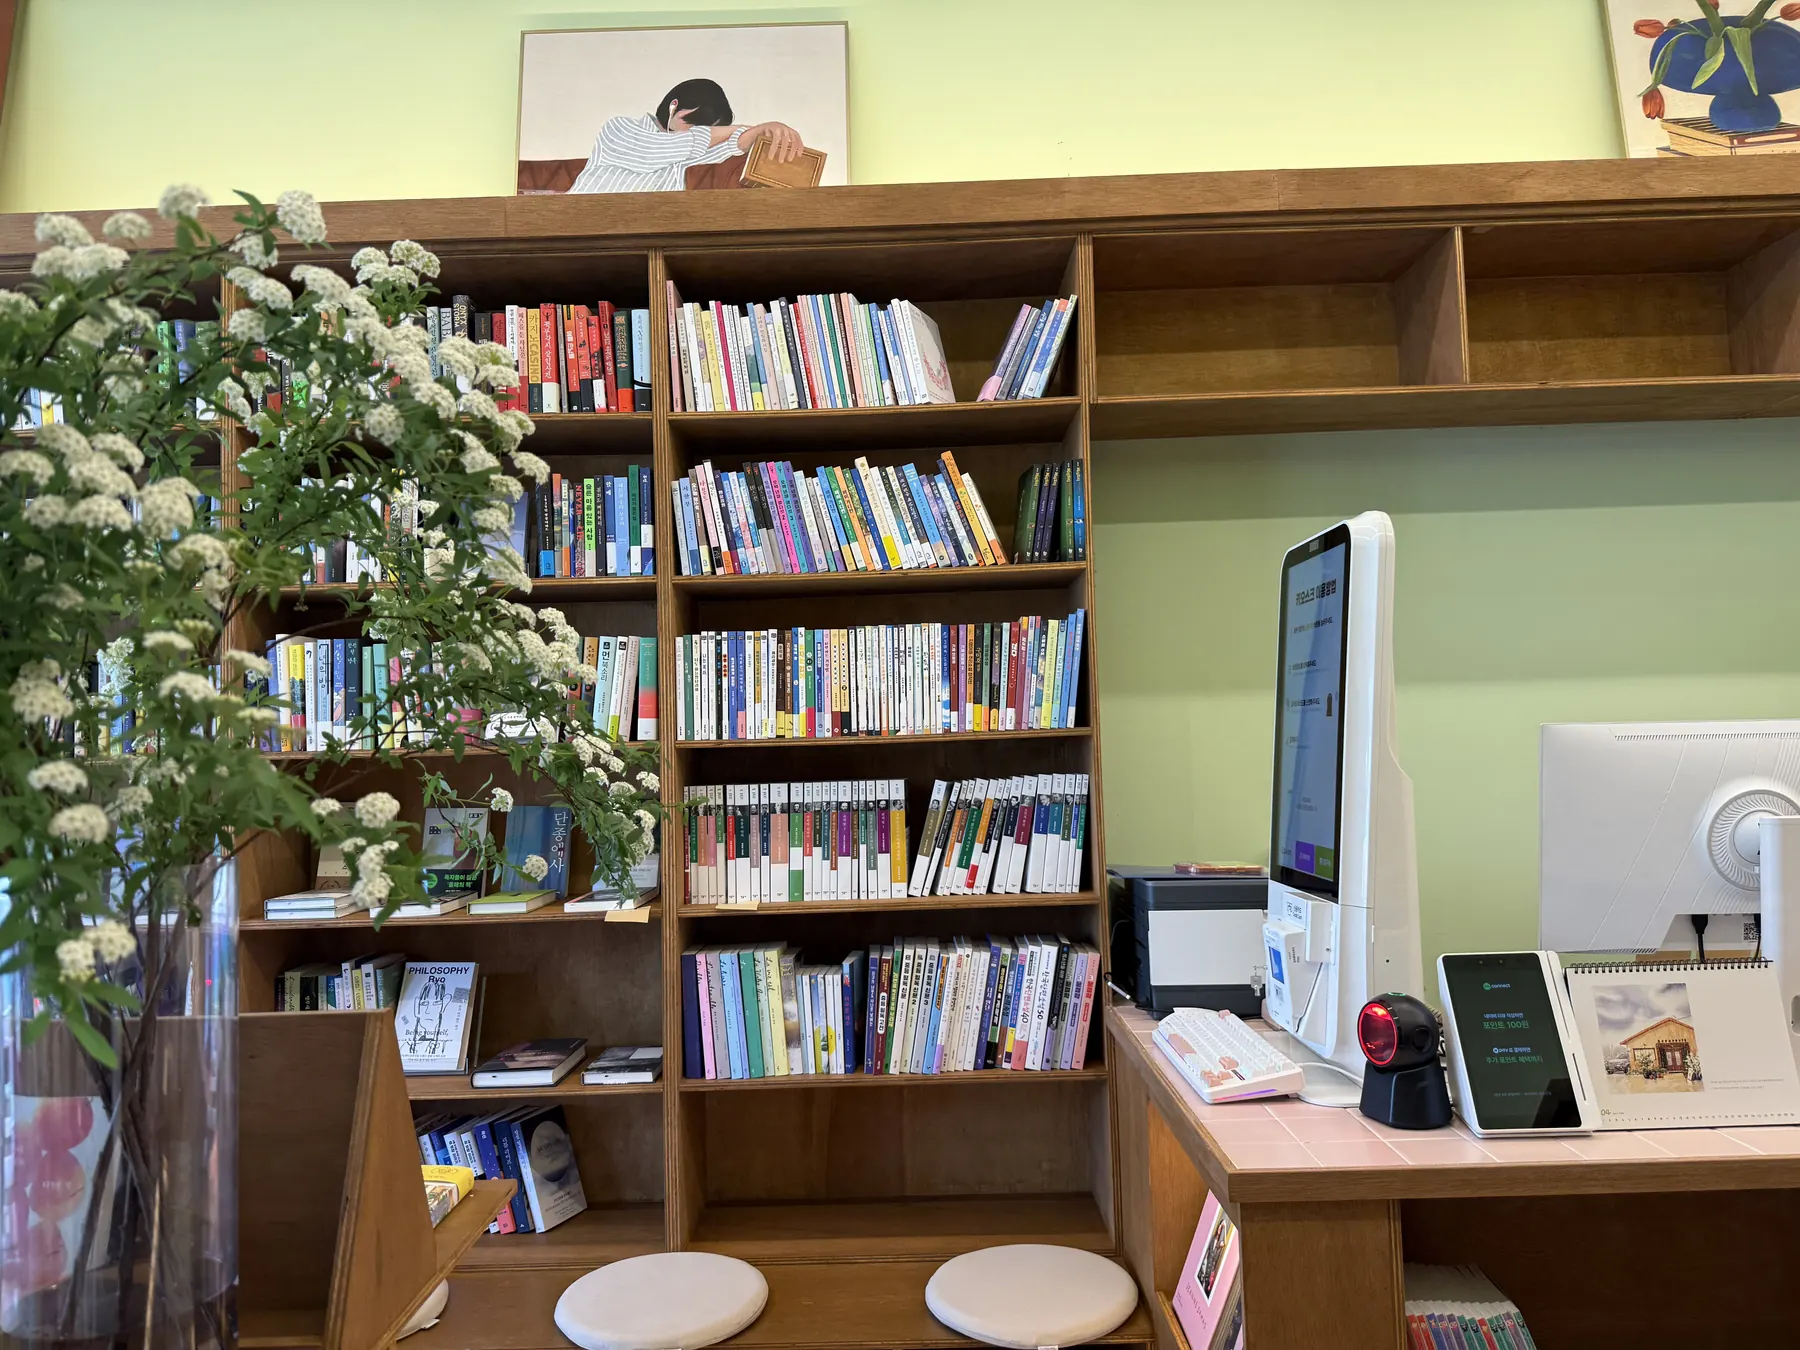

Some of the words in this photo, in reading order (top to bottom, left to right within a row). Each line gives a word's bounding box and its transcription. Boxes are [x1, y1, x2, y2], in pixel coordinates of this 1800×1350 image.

[529, 314, 539, 342] 카지노
[529, 344, 540, 383] CASINO
[586, 498, 592, 511] 마음
[586, 513, 593, 526] 있는
[586, 528, 593, 540] 사람
[1296, 587, 1315, 606] 키오스크
[1316, 578, 1337, 599] 이용방법
[602, 651, 609, 660] 먼
[548, 811, 569, 873] 단종애사
[408, 966, 470, 976] PHILOSOPHY
[427, 975, 446, 985] Ryo
[1483, 1021, 1506, 1029] 포인트
[1507, 1021, 1529, 1029] 100원
